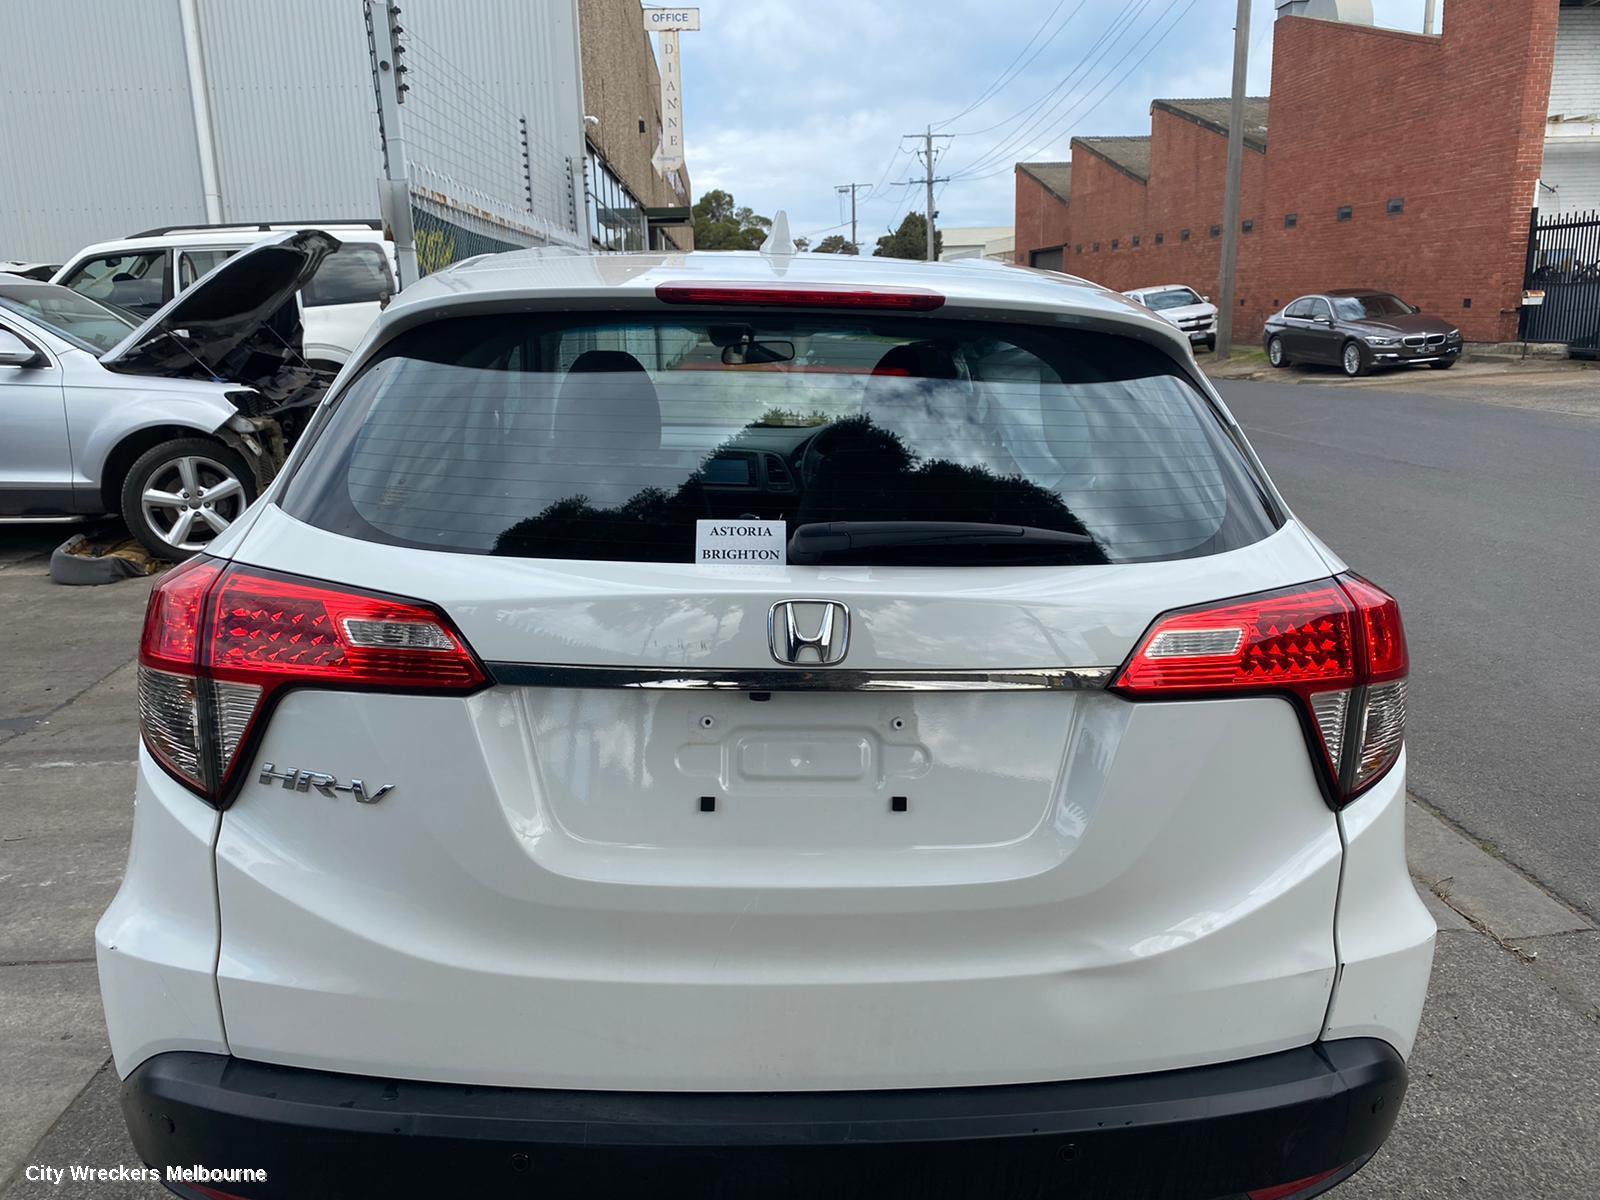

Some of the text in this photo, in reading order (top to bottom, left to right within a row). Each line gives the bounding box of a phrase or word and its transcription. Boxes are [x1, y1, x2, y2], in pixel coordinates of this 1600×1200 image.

[652, 13, 688, 23] OFFICE
[664, 43, 678, 146] DIANNE
[710, 526, 773, 537] ASTORIA
[702, 549, 780, 560] BRIGHTON
[259, 762, 396, 804] HR-V
